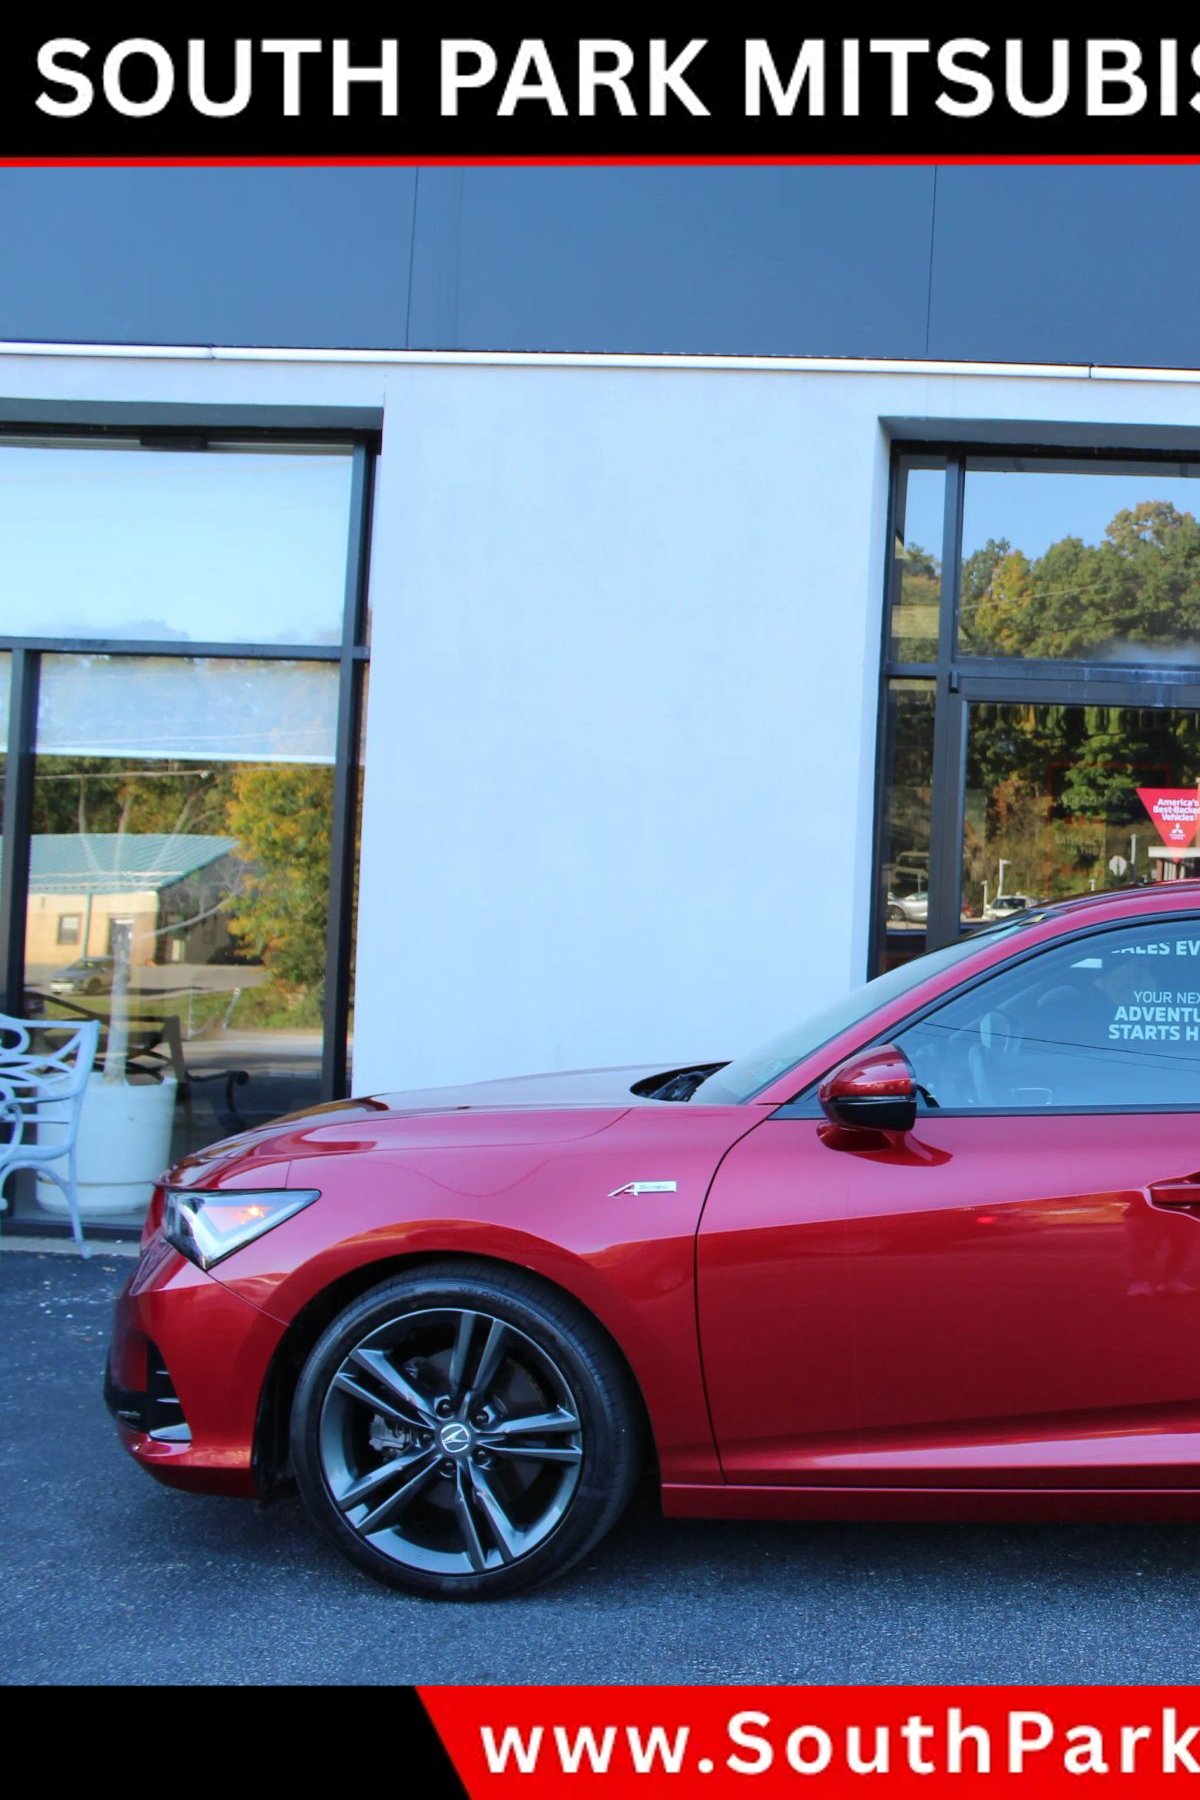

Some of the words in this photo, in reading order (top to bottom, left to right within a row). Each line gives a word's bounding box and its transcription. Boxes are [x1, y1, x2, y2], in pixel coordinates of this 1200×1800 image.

[1157, 798, 1199, 806] America's
[1161, 813, 1195, 821] Vehicles
[1111, 942, 1171, 955] LES
[1133, 991, 1172, 1003] YOUR
[1108, 1024, 1181, 1040] STARTS
